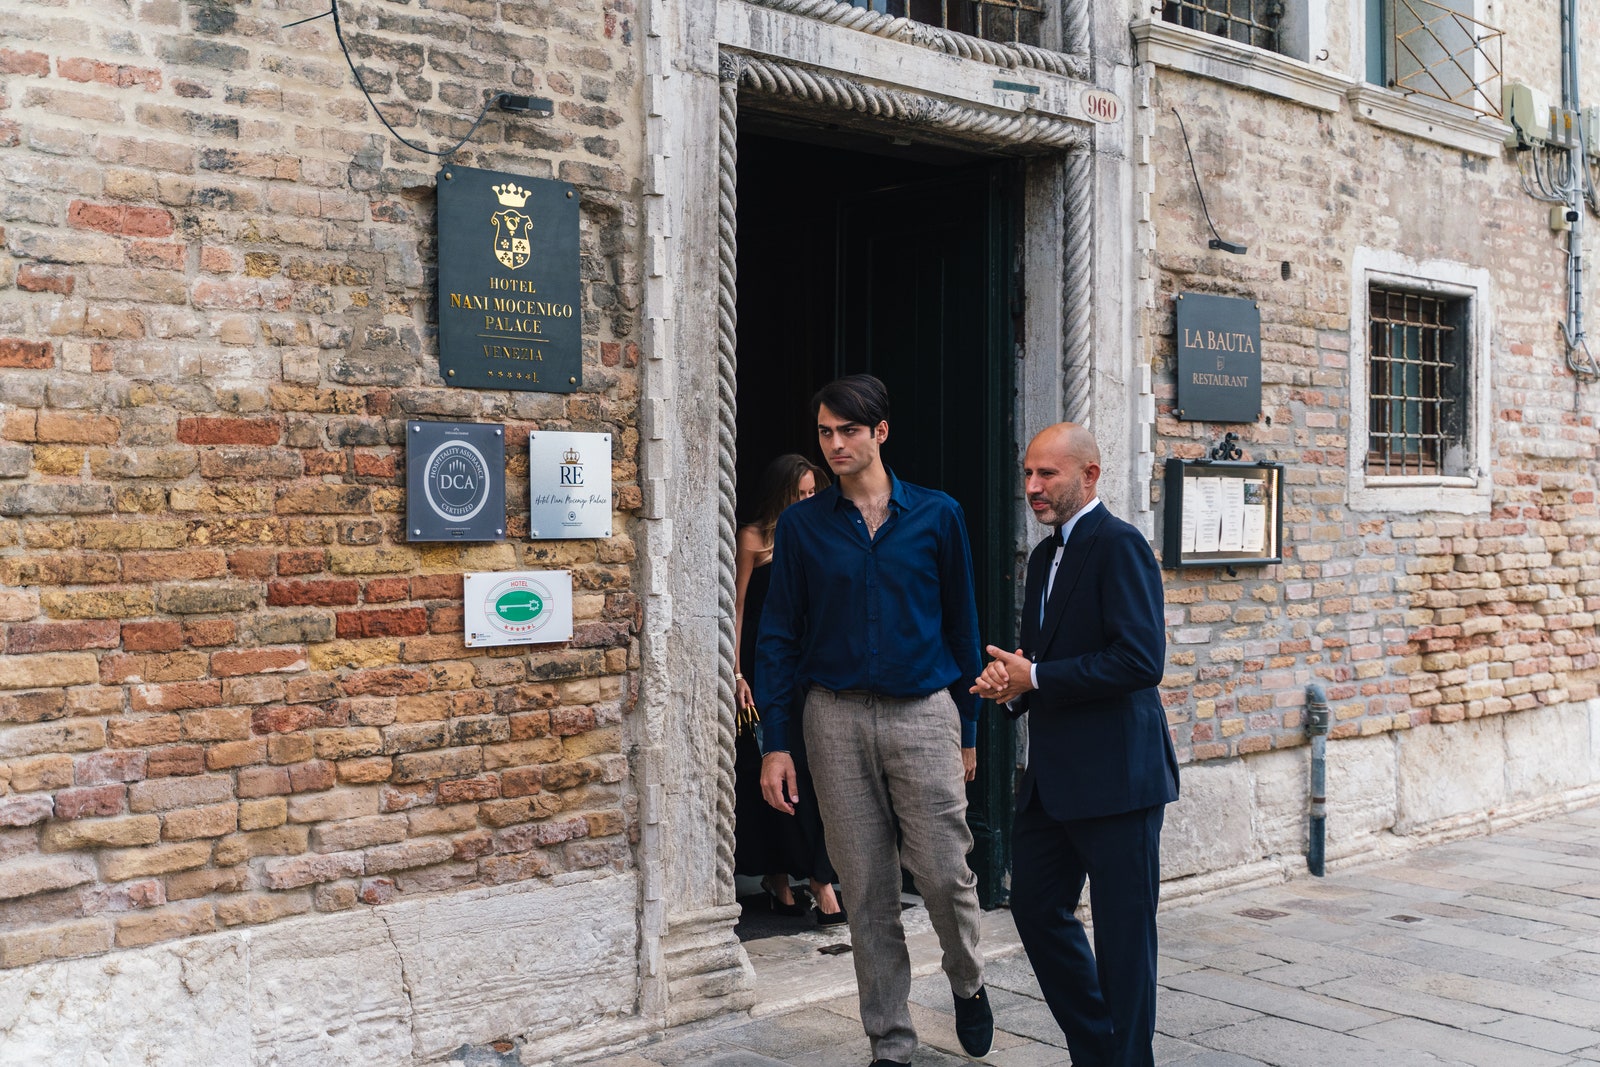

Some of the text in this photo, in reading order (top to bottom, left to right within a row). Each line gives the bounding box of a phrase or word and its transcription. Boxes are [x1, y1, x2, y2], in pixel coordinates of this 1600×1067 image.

[1087, 94, 1118, 120] 960
[489, 277, 537, 294] HOTEL
[450, 293, 573, 318] NANI MOCENIGO
[484, 315, 542, 334] PALACE
[1184, 328, 1256, 354] LA BAUTA
[482, 344, 543, 361] VENEZIA
[1192, 372, 1249, 388] RESTAURANT
[430, 447, 485, 479] HOSPITALITY ASSURANCE
[440, 474, 475, 489] DCA
[559, 465, 584, 484] RE
[441, 502, 474, 515] CERTIFIED
